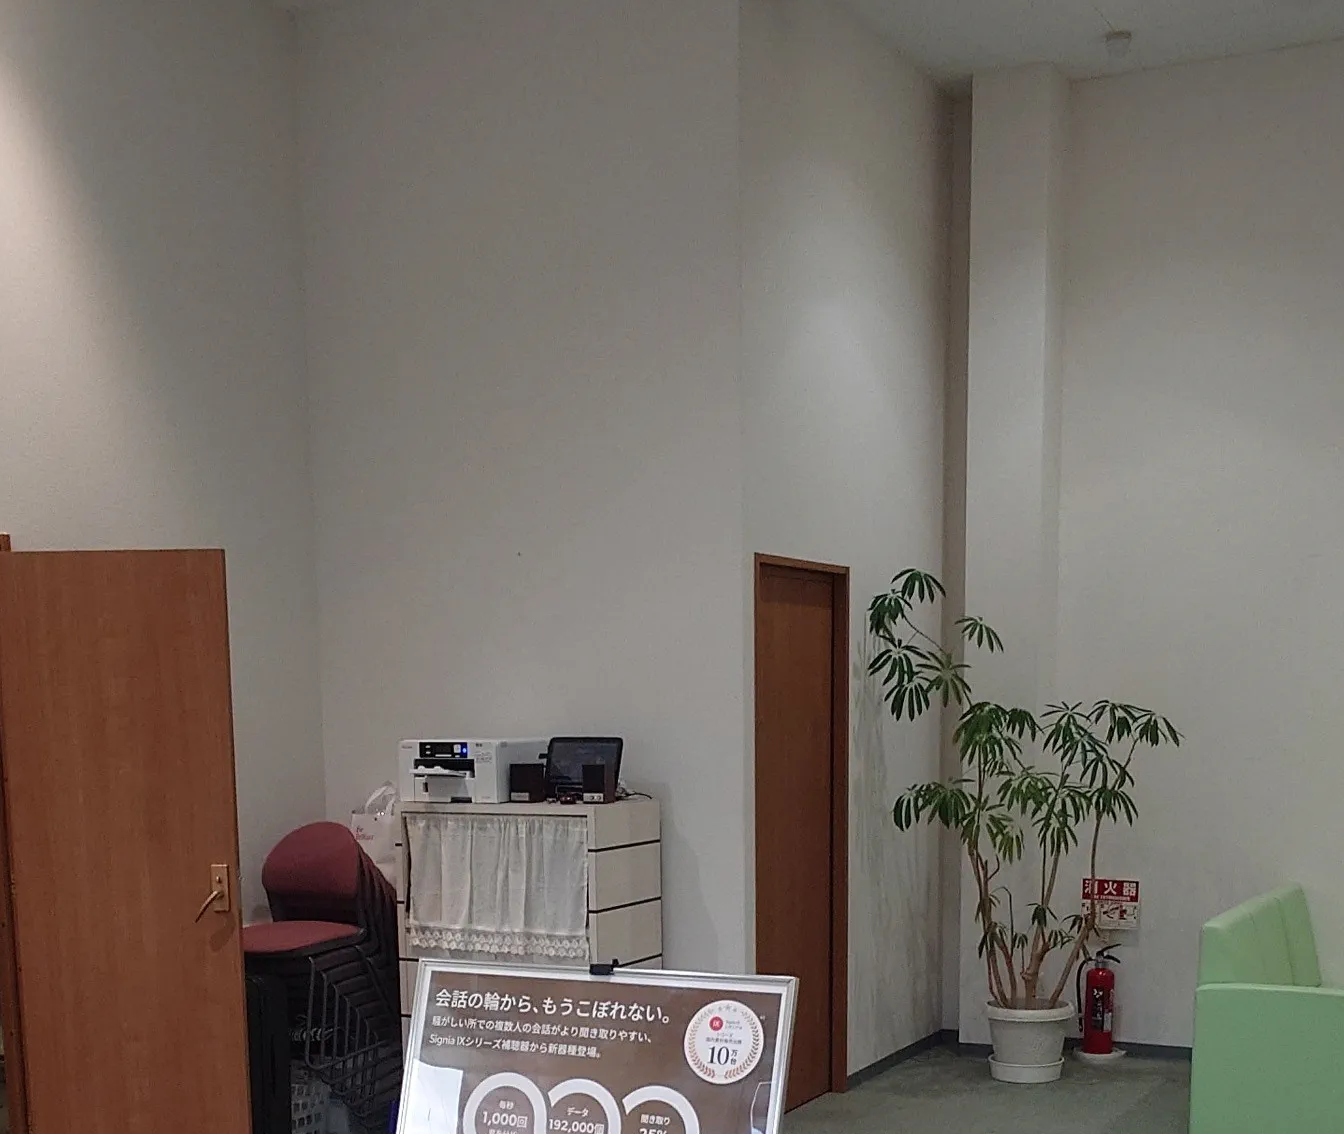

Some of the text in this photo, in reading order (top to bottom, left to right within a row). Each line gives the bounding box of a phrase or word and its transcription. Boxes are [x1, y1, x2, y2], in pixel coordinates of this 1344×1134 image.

[1084, 880, 1136, 897] 消火器
[435, 988, 671, 1024] 会話の輪から、もうこぼれない。
[432, 1015, 652, 1043] 騒がしい所での複数人の会話がより聞き取りやすい、
[429, 1033, 456, 1048] Signia
[482, 1111, 529, 1129] 1,000回
[566, 1107, 589, 1117] データ
[640, 1114, 671, 1126] 聞き取り
